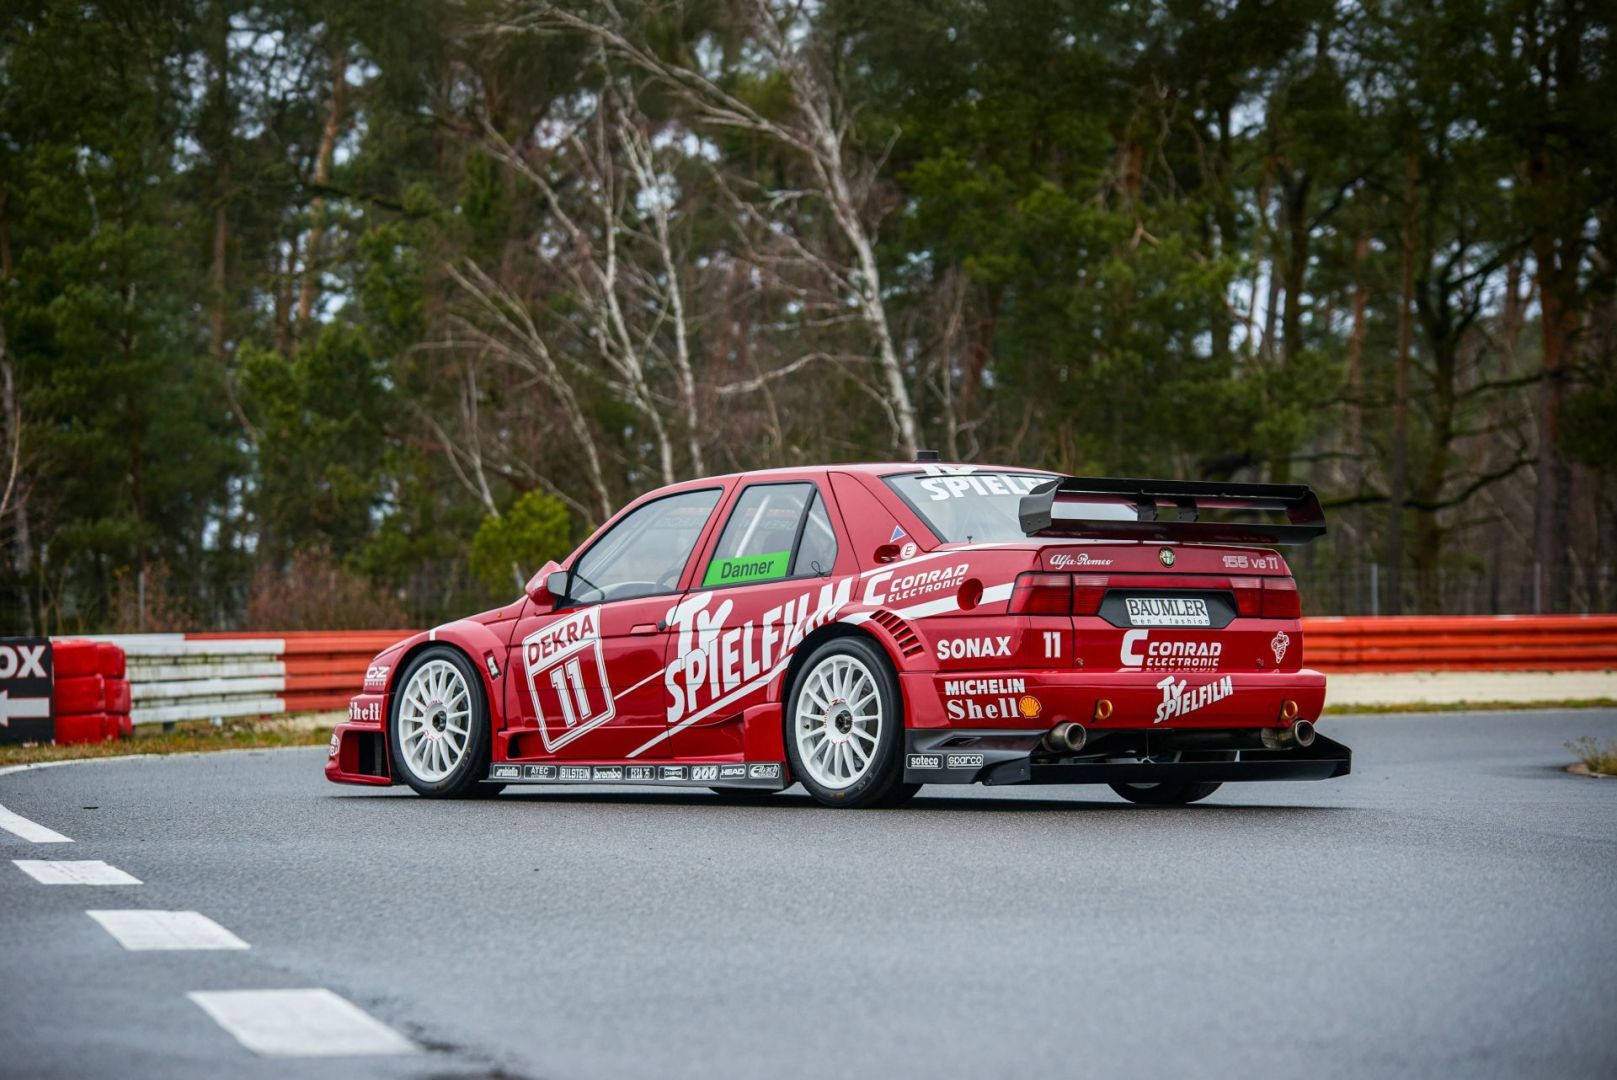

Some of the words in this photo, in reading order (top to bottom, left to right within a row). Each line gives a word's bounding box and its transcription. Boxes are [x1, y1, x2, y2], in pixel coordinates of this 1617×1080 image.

[721, 560, 775, 579] Danner
[1049, 554, 1075, 570] Alfa
[1077, 553, 1114, 566] Romeo
[1222, 555, 1249, 569] 155
[889, 563, 970, 593] CONRAD
[888, 577, 964, 603] ELECTRONIC
[1168, 617, 1210, 625] fashion
[665, 591, 733, 670] TV
[527, 614, 594, 667] DEKRA
[664, 576, 854, 723] SPIELFILM
[936, 635, 1012, 660] SONAX
[1043, 631, 1061, 658] 11
[1148, 641, 1222, 657] CONRAD
[1146, 657, 1220, 667] ELECTRONIC
[366, 666, 391, 679] OZ
[550, 656, 592, 729] 11
[945, 678, 1026, 696] MICHELIN
[1156, 675, 1187, 705] TV
[947, 697, 1020, 720] Shell
[1153, 675, 1234, 724] SPIELFILM
[911, 755, 939, 765] soteco
[948, 755, 982, 767] sparco
[530, 766, 549, 775] ATEC
[561, 768, 590, 778] BILSTEIN
[594, 768, 622, 778] brembo
